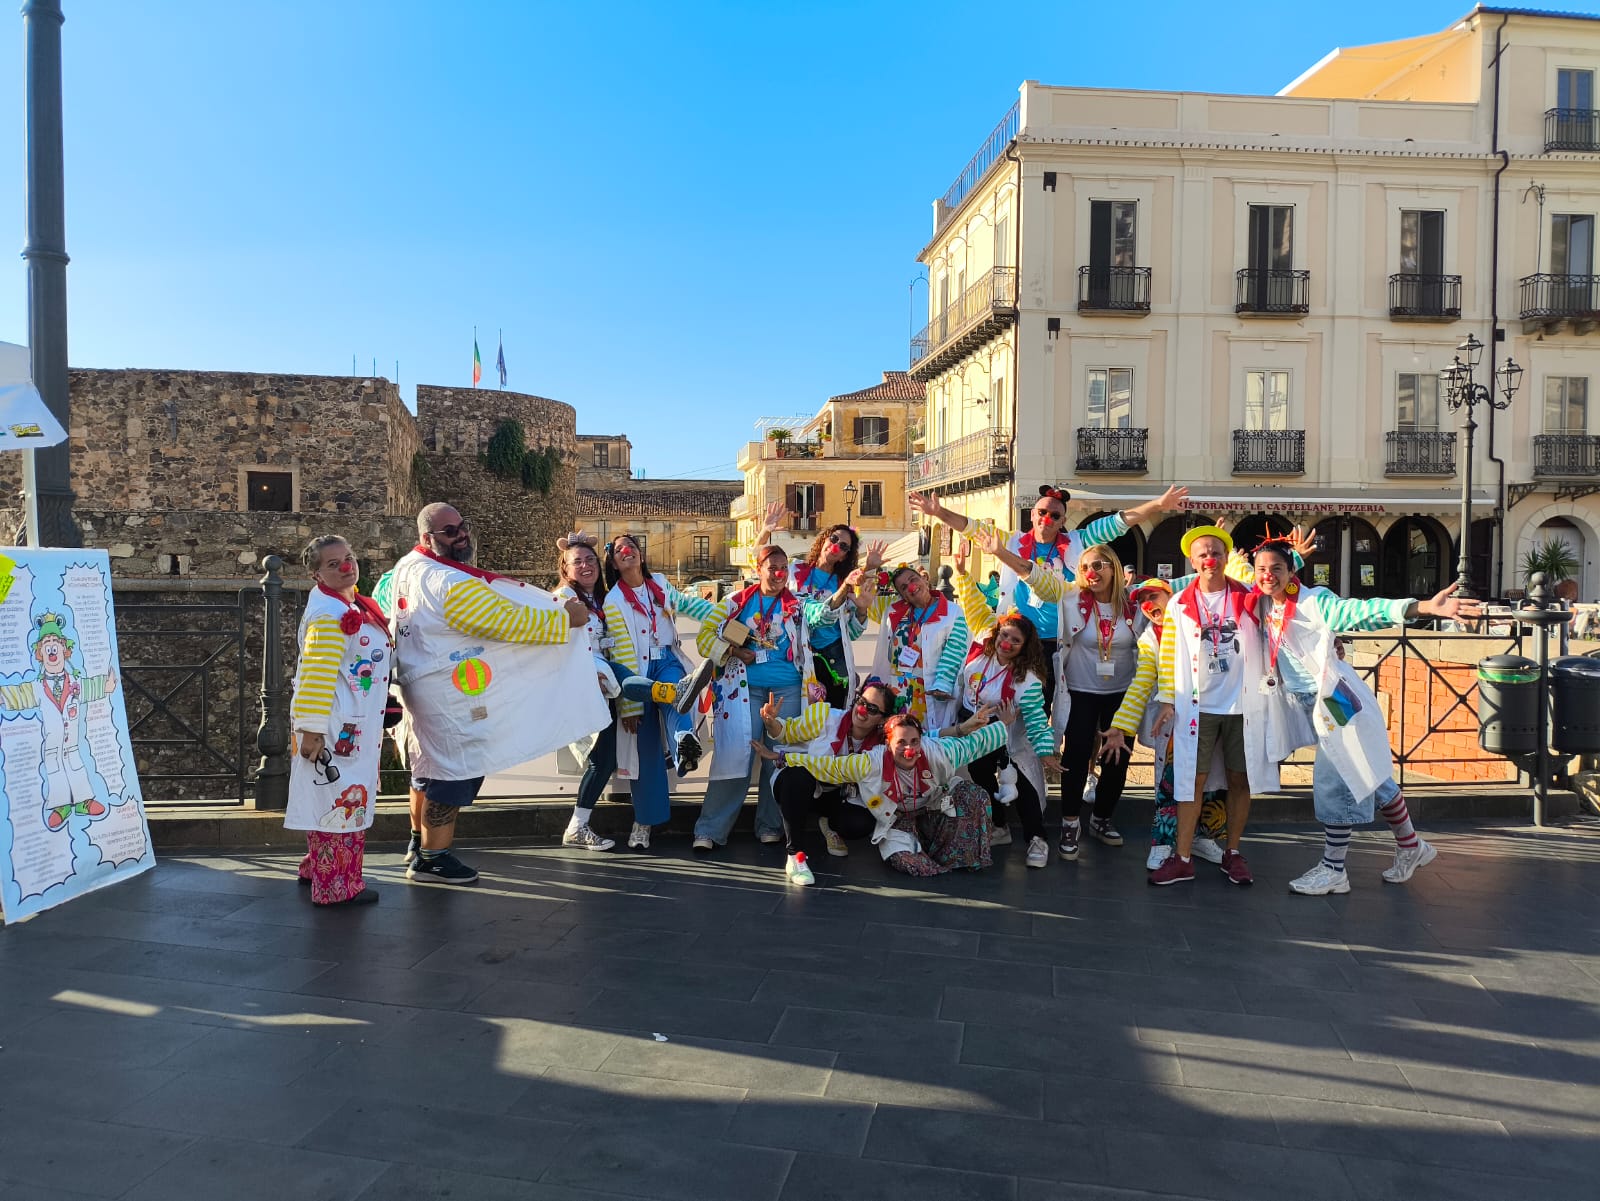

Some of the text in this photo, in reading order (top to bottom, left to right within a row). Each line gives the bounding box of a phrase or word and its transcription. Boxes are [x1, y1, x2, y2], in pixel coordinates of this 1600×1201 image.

[1250, 503, 1263, 511] LE
[1266, 503, 1334, 512] CASTELLANE
[1338, 504, 1385, 512] PIZZERIA
